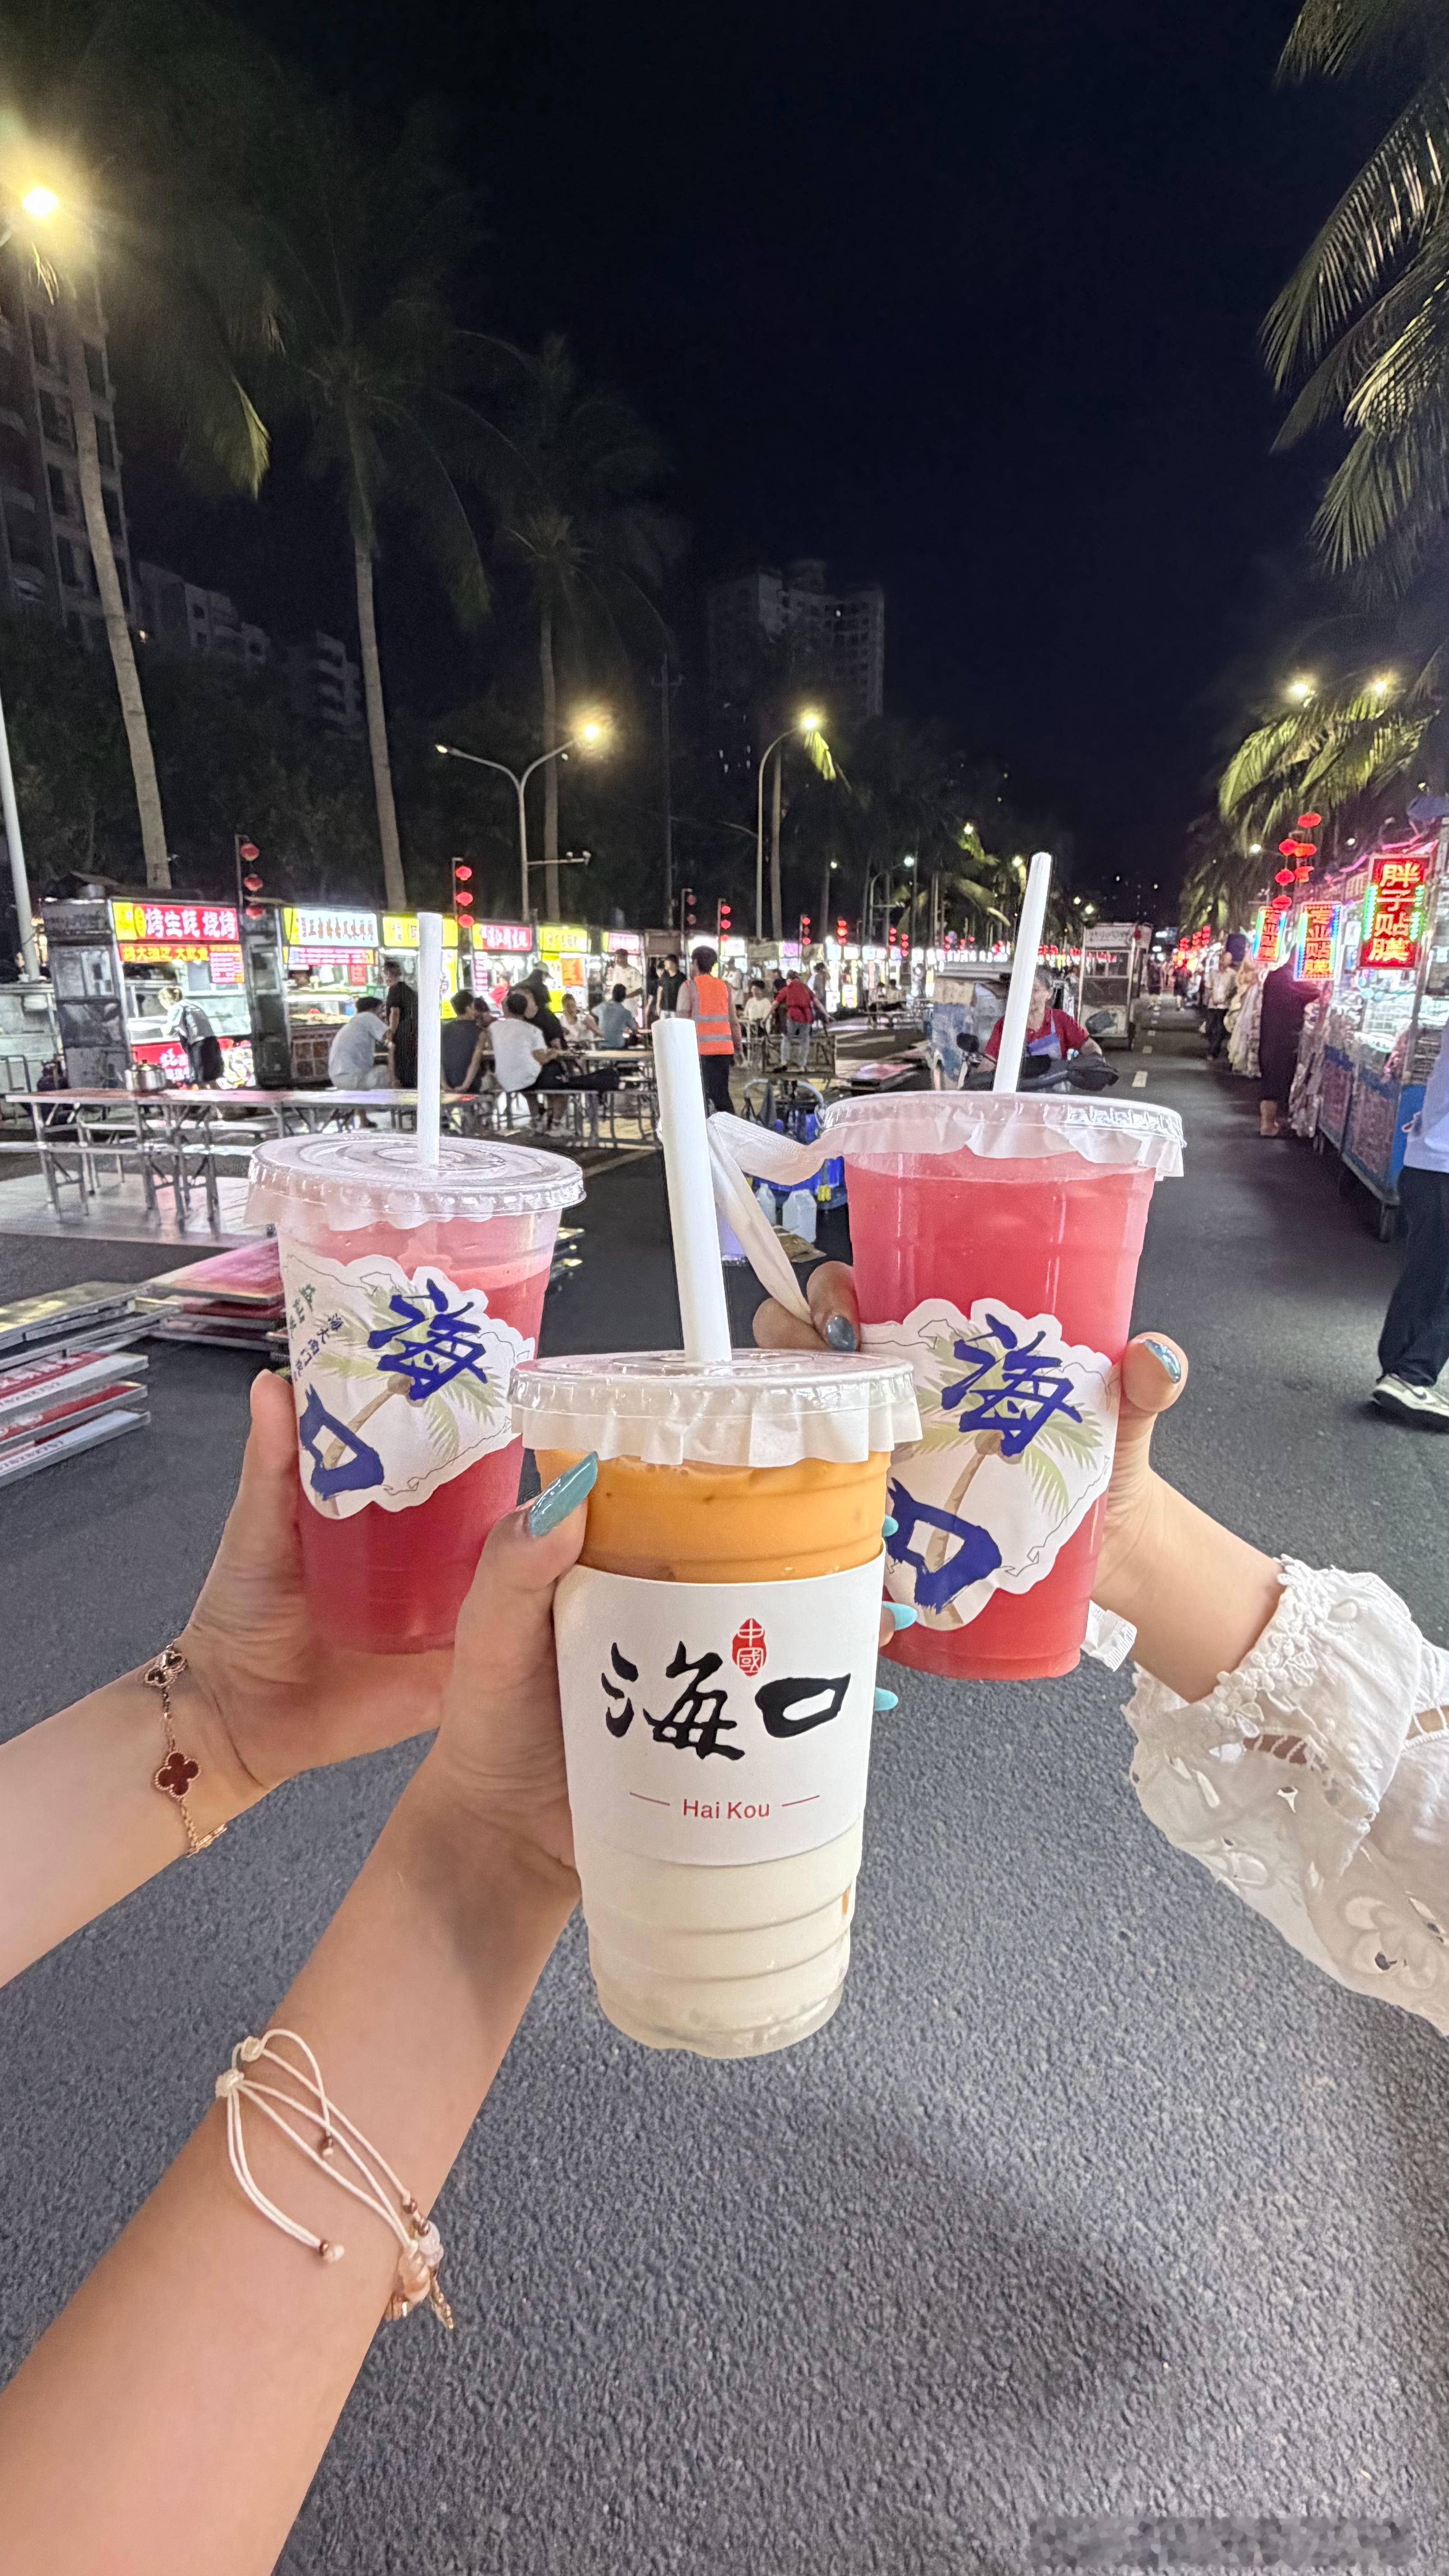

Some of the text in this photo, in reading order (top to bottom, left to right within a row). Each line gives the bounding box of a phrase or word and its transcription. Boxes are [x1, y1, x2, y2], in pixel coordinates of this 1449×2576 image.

[1303, 907, 1333, 975] 专业贴膜
[1368, 861, 1420, 961] 胖子贴膜
[299, 1278, 488, 1501] 海口
[886, 1313, 1082, 1614] 海口
[601, 1641, 851, 1760] 海口
[683, 1799, 769, 1819] Hai Kou
